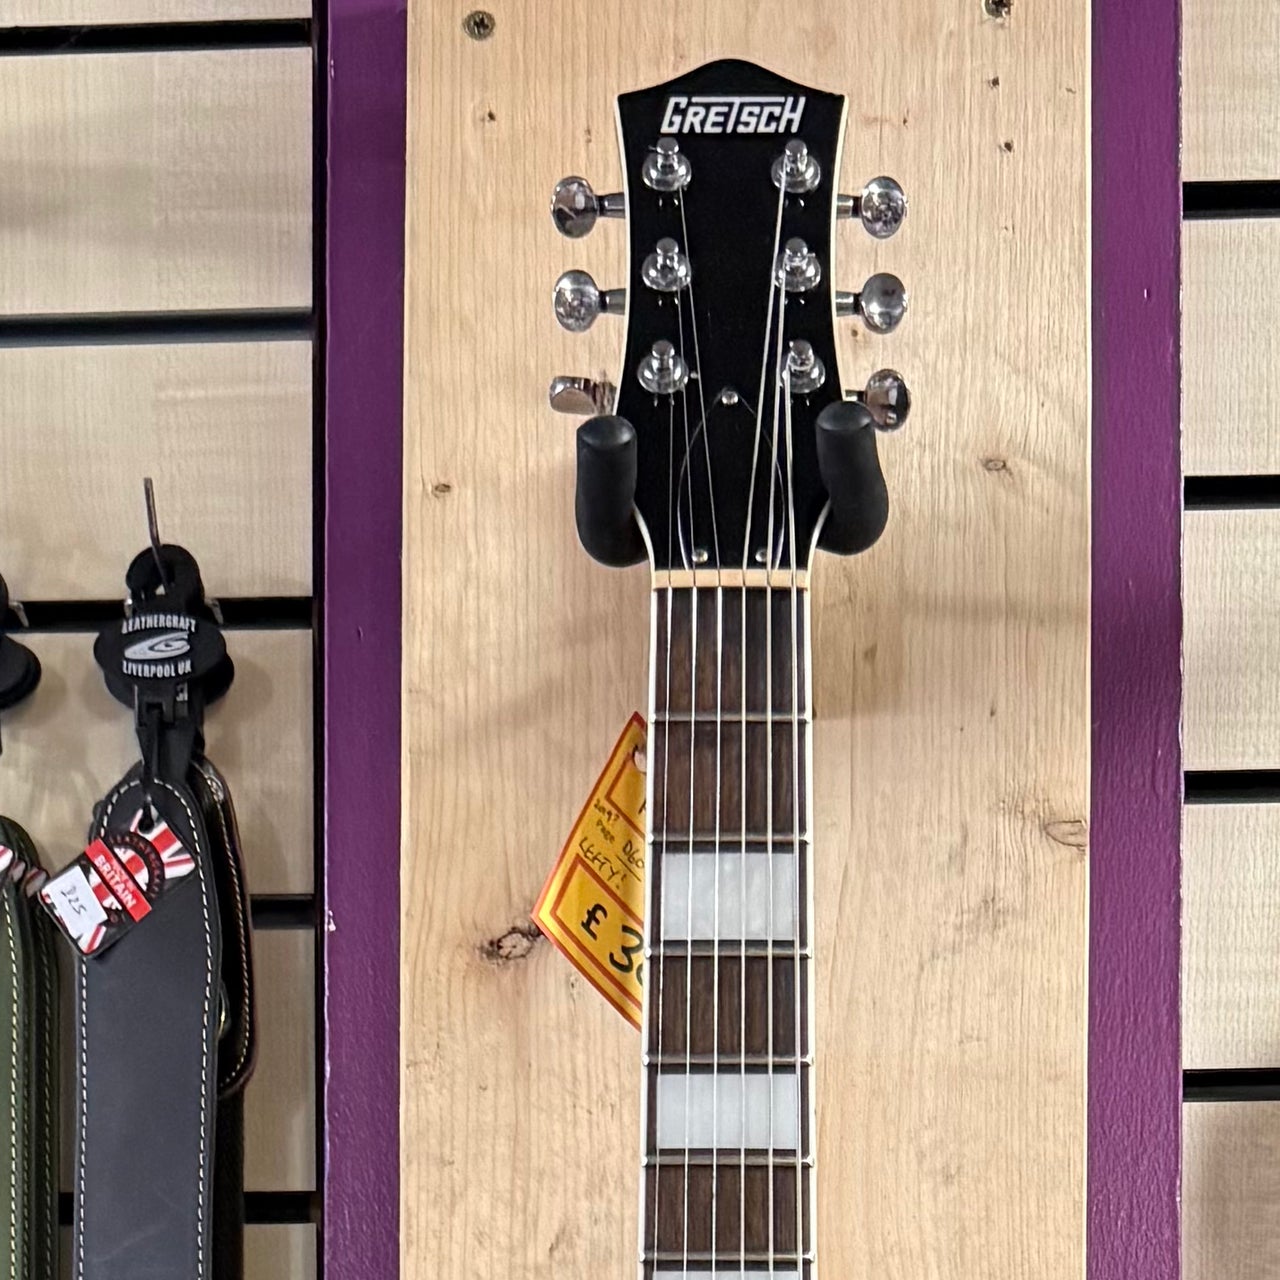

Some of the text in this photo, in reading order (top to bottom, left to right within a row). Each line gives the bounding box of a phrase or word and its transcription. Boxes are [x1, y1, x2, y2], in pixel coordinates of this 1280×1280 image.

[660, 96, 807, 134] GRETSCH
[122, 660, 192, 678] LIVERPOOL UK
[94, 855, 137, 908] BRITAIN
